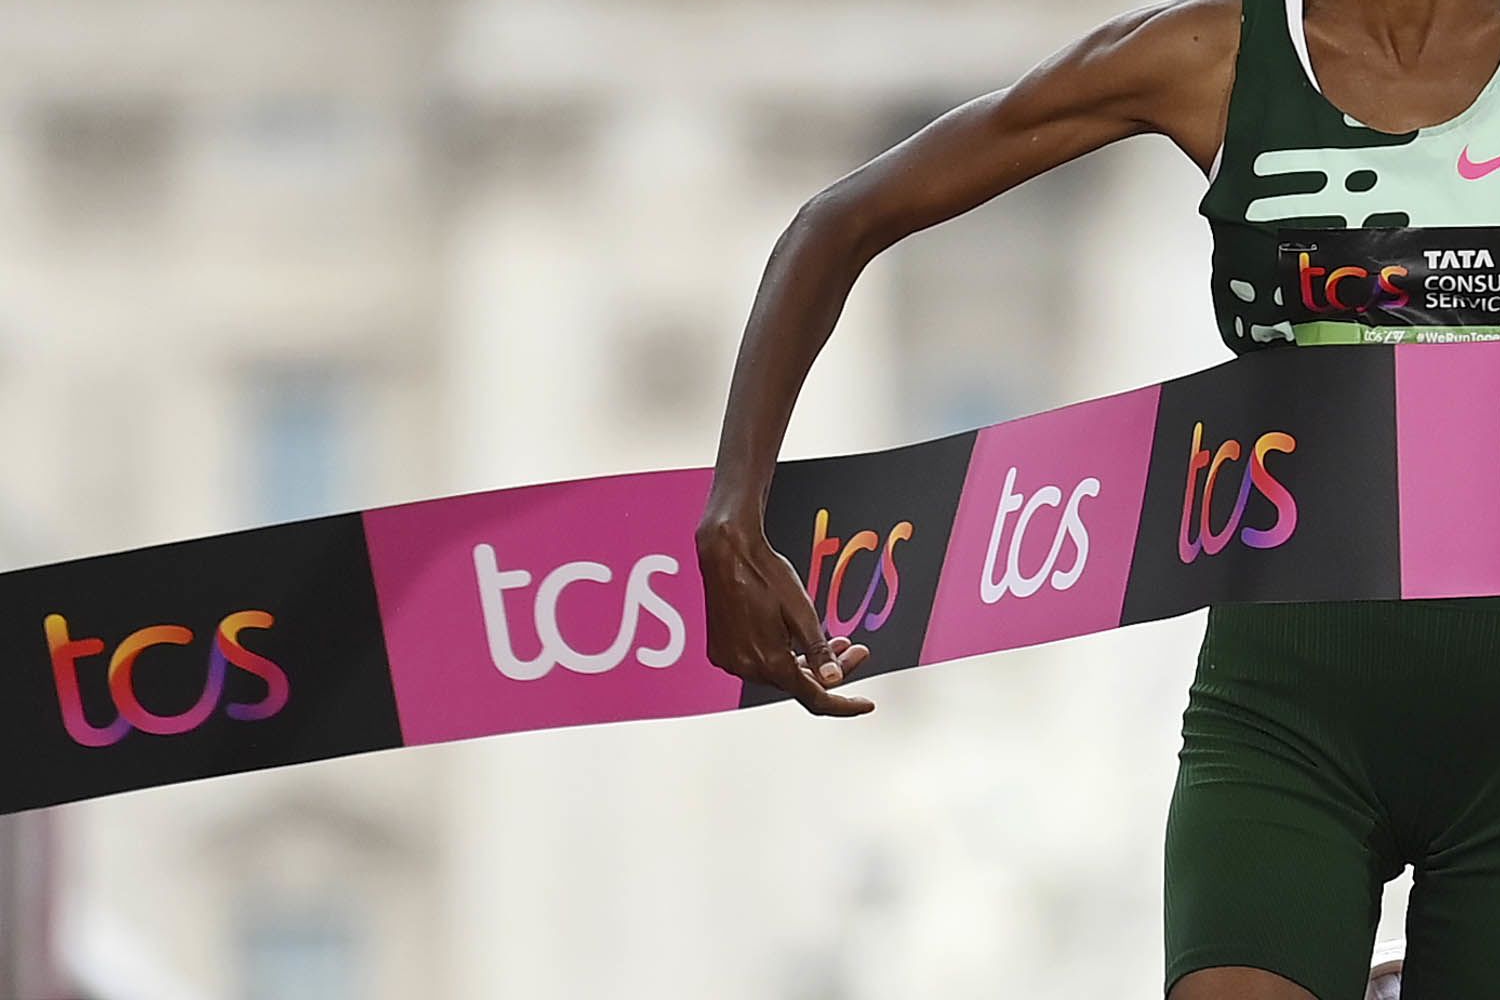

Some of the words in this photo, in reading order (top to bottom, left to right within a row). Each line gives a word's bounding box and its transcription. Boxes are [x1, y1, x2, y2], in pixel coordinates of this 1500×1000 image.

[1299, 252, 1410, 312] tcs
[1423, 249, 1495, 269] TATA
[980, 466, 1102, 605] tcs
[1177, 421, 1298, 564] tcs
[473, 543, 687, 681] tcs
[806, 508, 913, 638] tcs
[43, 610, 291, 748] tcs
